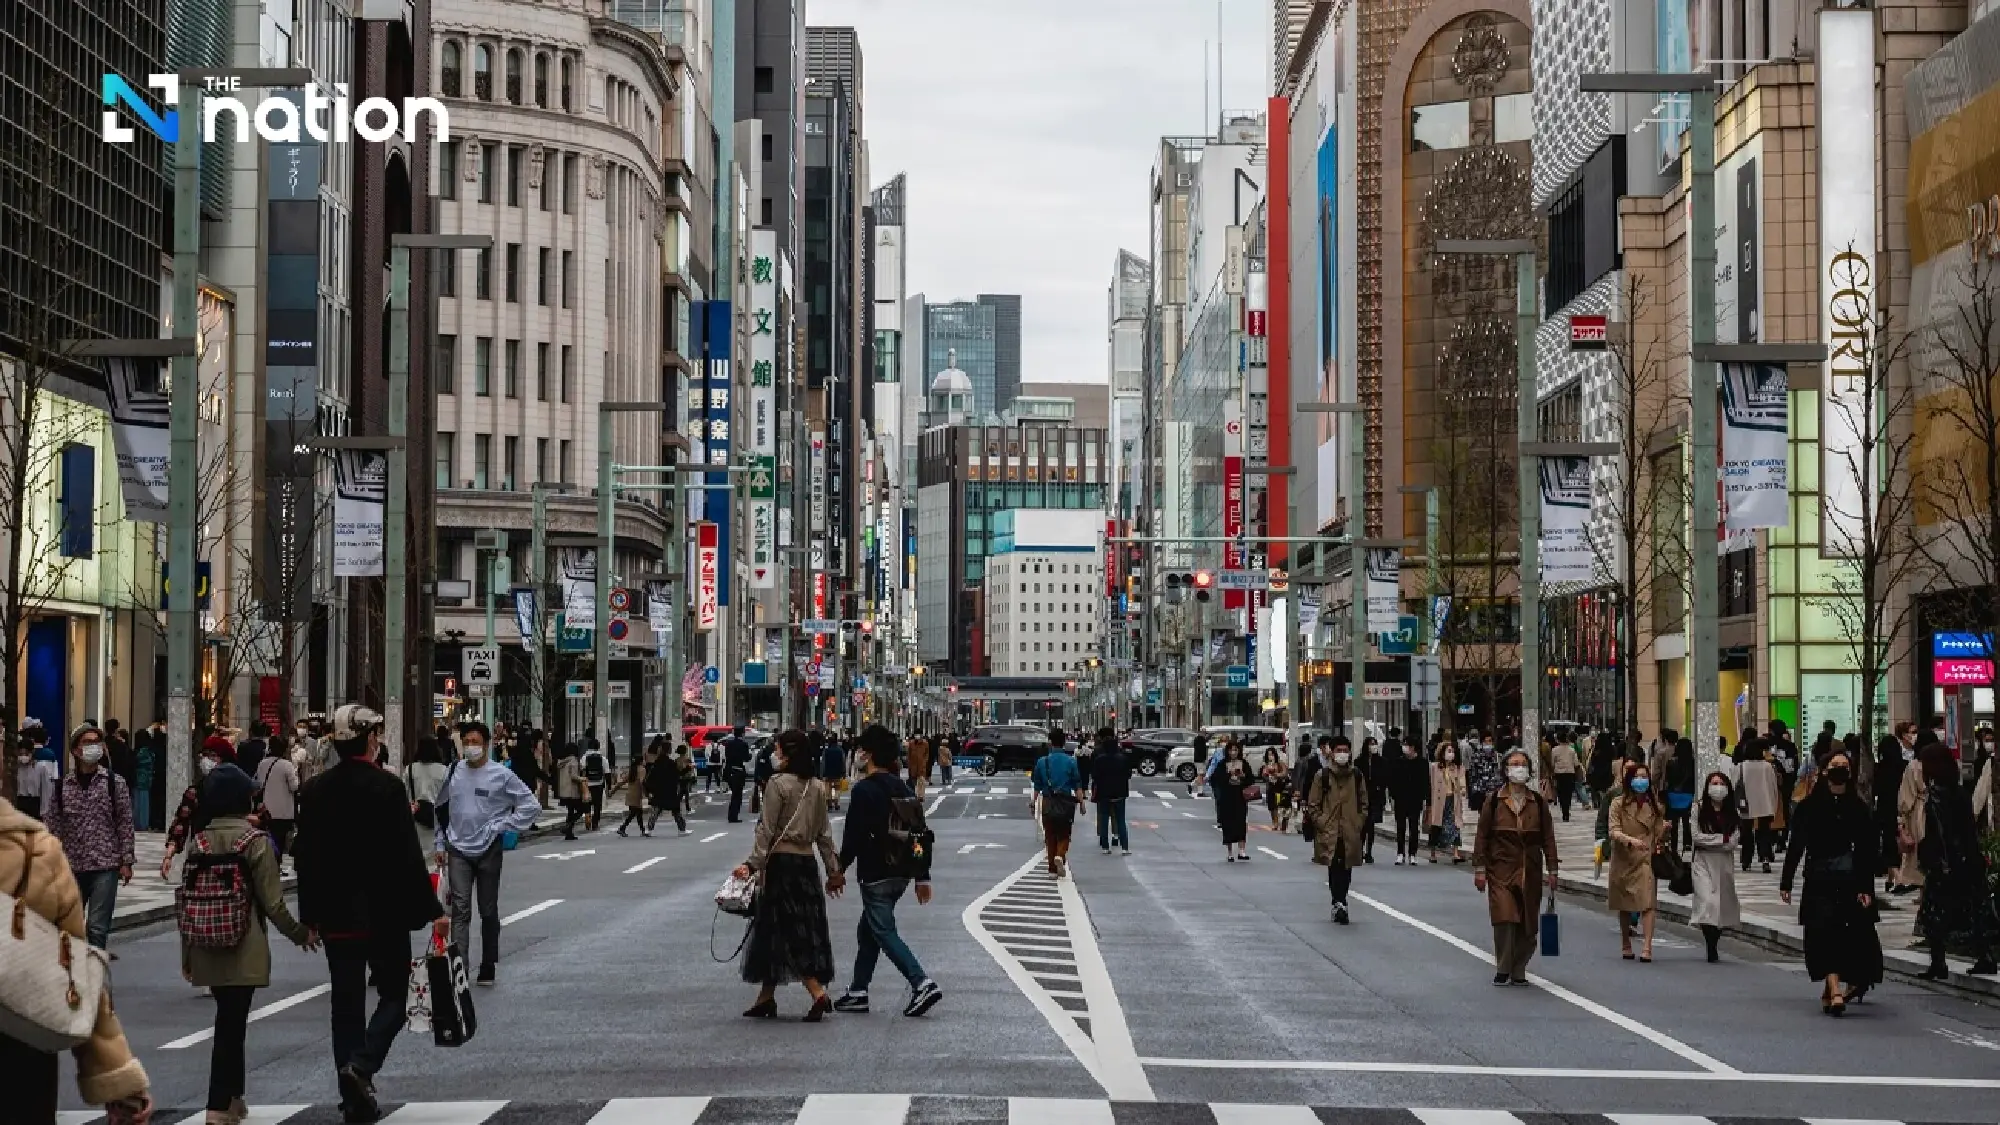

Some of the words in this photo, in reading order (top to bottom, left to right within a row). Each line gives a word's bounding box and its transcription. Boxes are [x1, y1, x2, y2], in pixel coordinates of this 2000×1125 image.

[751, 254, 772, 388] 教文館
[1829, 251, 1870, 397] CORE
[1751, 458, 1786, 467] CREATIVE
[467, 650, 495, 660] TAXI
